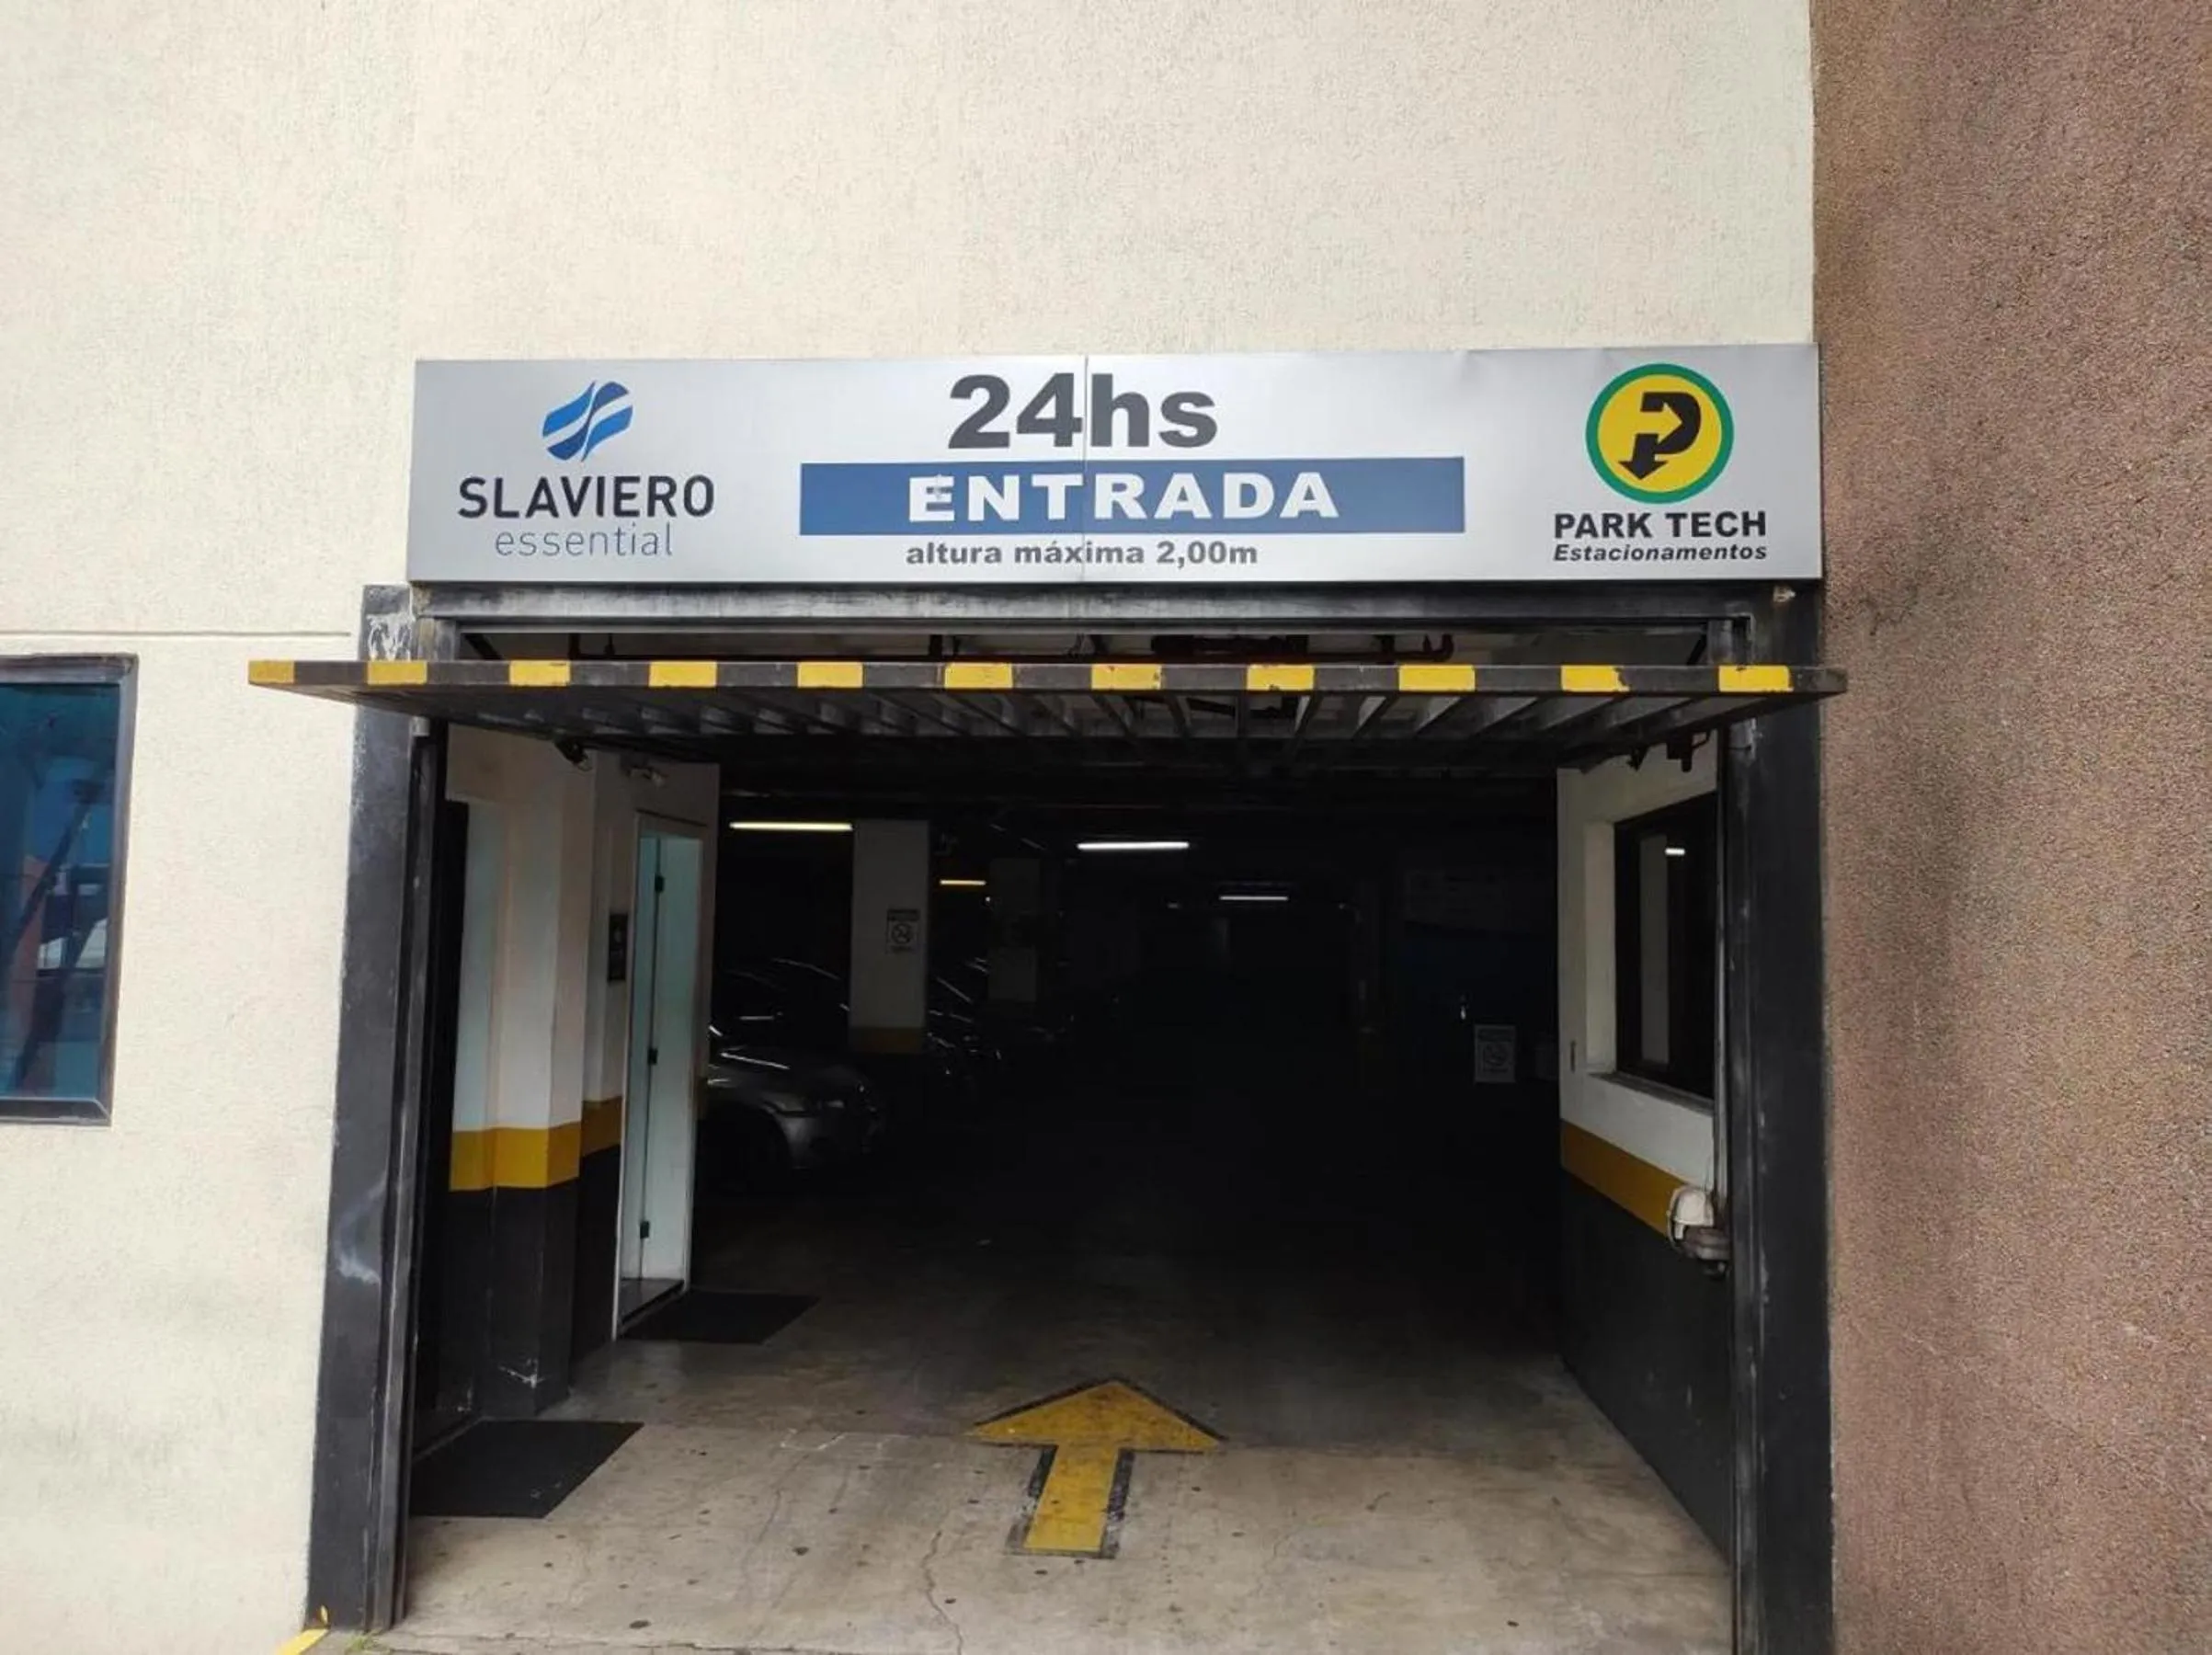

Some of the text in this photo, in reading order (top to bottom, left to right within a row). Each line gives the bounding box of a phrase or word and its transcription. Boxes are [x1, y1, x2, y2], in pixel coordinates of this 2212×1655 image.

[948, 372, 1218, 449] 24hs
[457, 474, 715, 519] SLAVIERO
[907, 472, 1340, 522] ENTRADA
[495, 522, 673, 557] essential
[1554, 510, 1767, 539] PARK TECH
[906, 540, 1259, 569] altura máxima 2,00m
[1553, 542, 1768, 563] Estacionamentos
